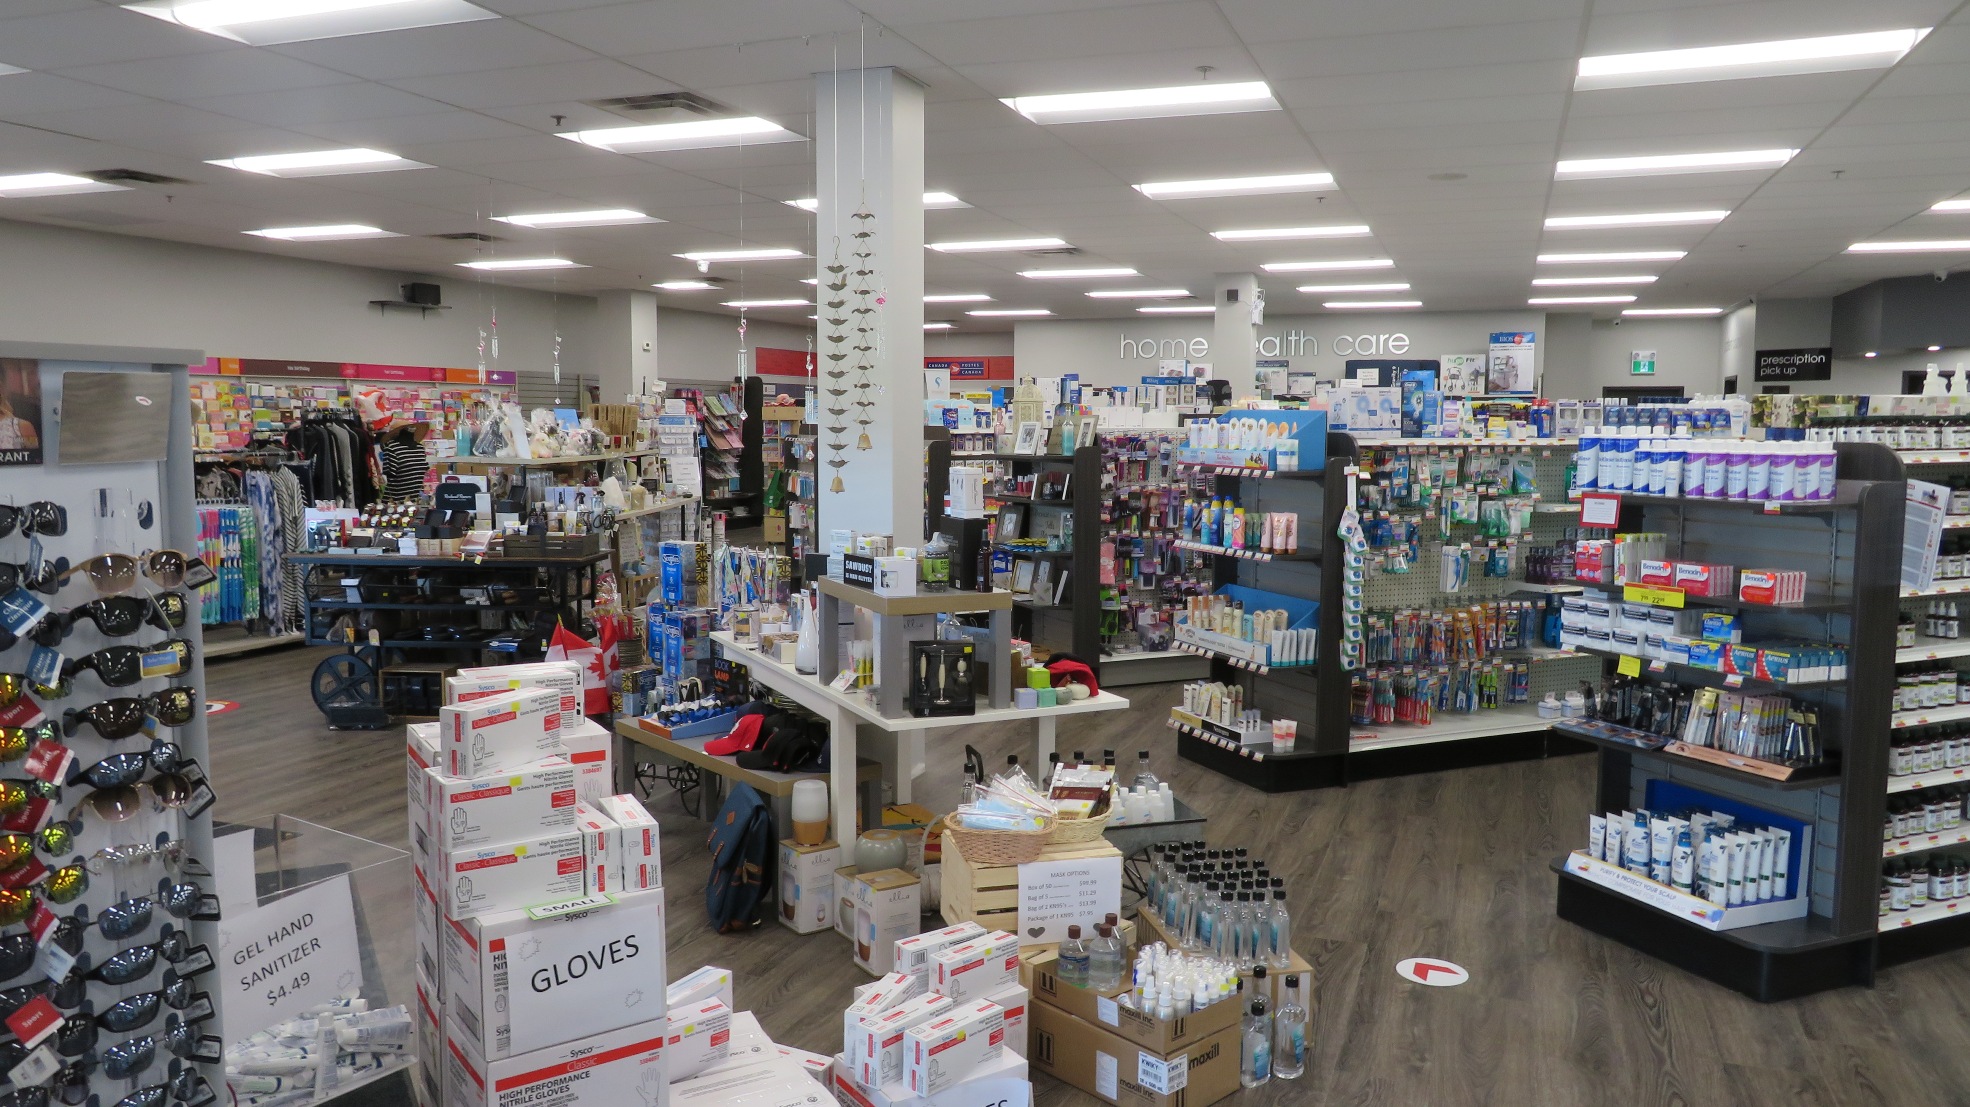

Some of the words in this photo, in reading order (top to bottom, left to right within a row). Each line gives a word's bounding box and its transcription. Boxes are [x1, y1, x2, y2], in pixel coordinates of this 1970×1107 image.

[1120, 334, 1209, 358] home
[1255, 329, 1319, 357] alth
[1332, 332, 1411, 357] care
[1761, 354, 1826, 367] prescription
[1760, 366, 1781, 376] pick
[1783, 367, 1797, 376] up
[845, 560, 873, 574] SAWDUST
[1744, 574, 1769, 583] Benadry
[487, 708, 500, 716] Sysco
[546, 769, 574, 778] Performance
[472, 782, 490, 790] Sysco
[544, 779, 574, 788] performance
[452, 792, 476, 802] Classic
[478, 788, 510, 798] Classique
[550, 836, 580, 845] Performance
[550, 846, 580, 856] performance
[458, 861, 480, 870] Classic
[484, 856, 516, 866] Classique
[1620, 874, 1643, 887] PROTECT
[1643, 882, 1660, 894] YOUR
[542, 898, 600, 913] SMALL
[564, 911, 590, 922] Sysco
[234, 942, 264, 965] GEL
[268, 913, 314, 946] HAND
[240, 938, 322, 992] SANITIZER
[531, 934, 640, 993] GLOVES
[266, 972, 310, 1006] $4.49
[22, 1011, 44, 1028] Sport
[1120, 1006, 1142, 1020] maxill
[570, 1046, 595, 1058] Sysco
[1188, 1042, 1220, 1070] maxill
[566, 1056, 598, 1072] Classic
[500, 1090, 524, 1101] HIGH
[524, 1070, 590, 1094] PERFORMANCE
[1120, 1079, 1142, 1093] maxill
[500, 1096, 534, 1107] NITRILE
[535, 1084, 570, 1100] GLOVES
